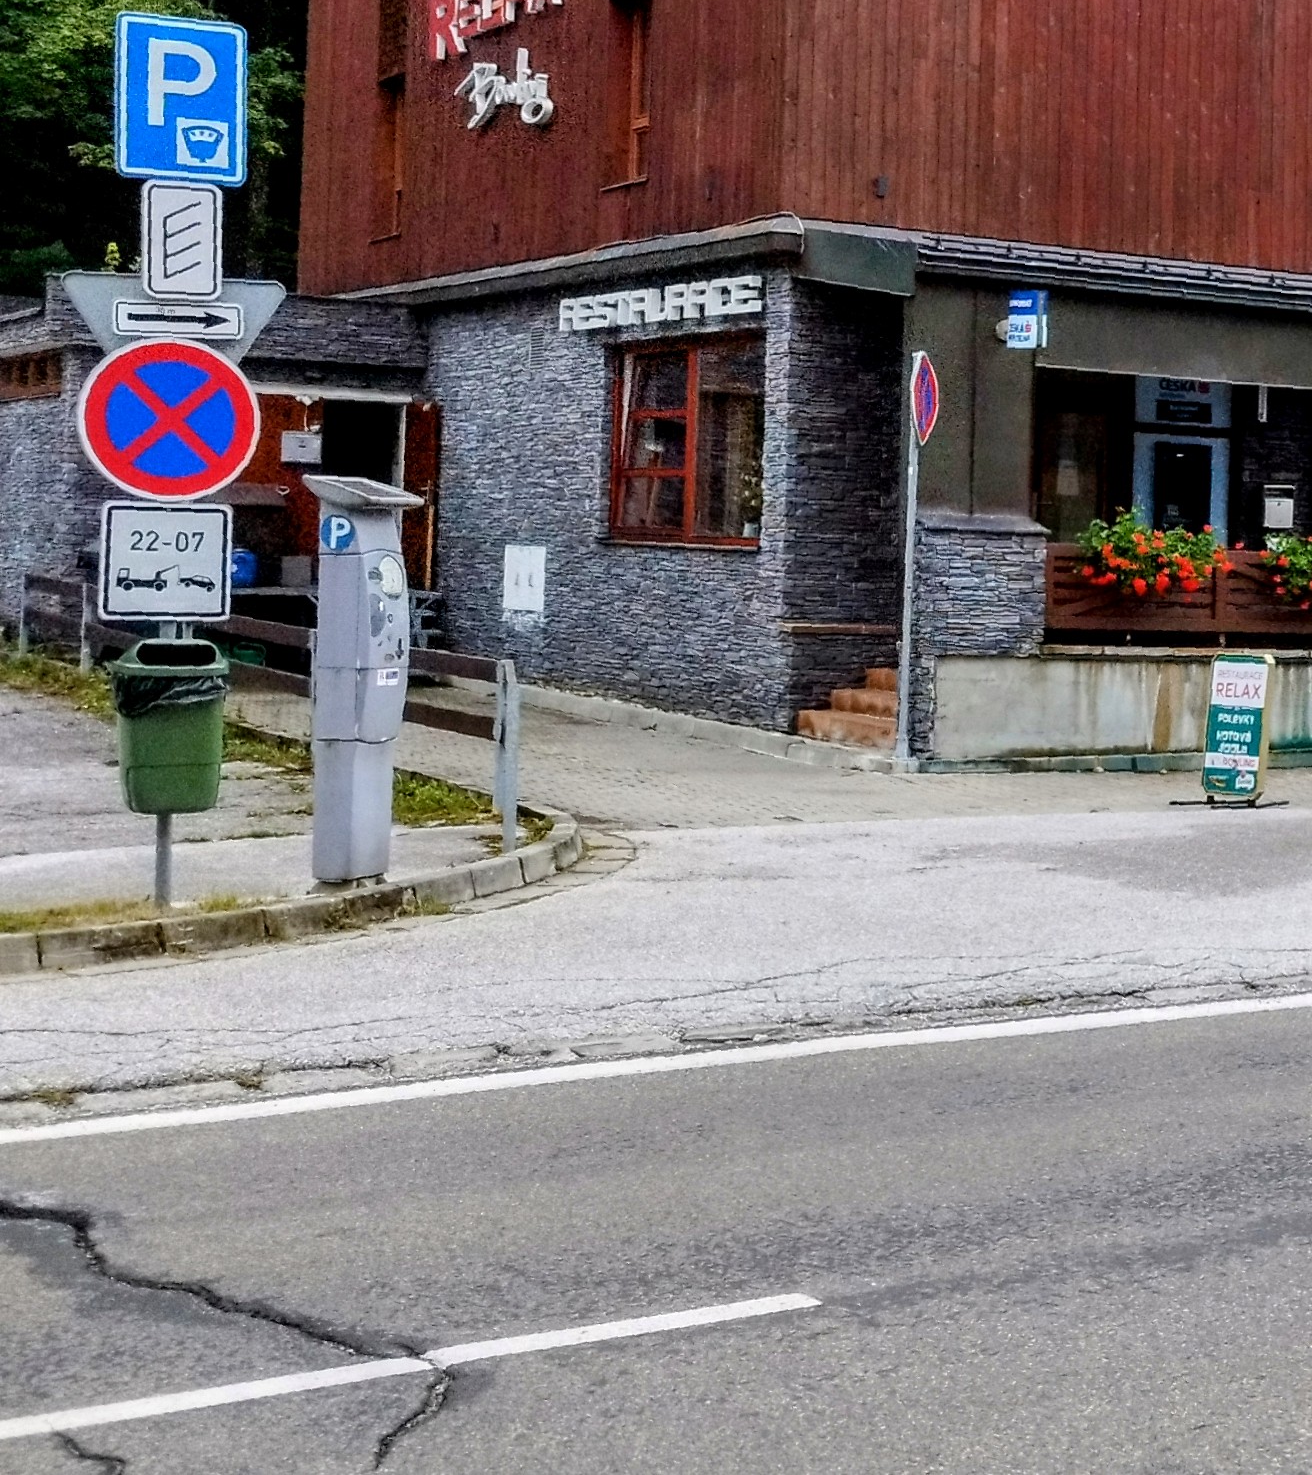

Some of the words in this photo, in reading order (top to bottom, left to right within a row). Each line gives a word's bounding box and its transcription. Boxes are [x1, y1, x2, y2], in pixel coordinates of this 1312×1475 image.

[148, 38, 217, 126] P
[559, 275, 763, 331] RESTAURACE
[130, 530, 205, 552] 22-07
[330, 517, 350, 549] P
[1216, 683, 1262, 699] RELAX
